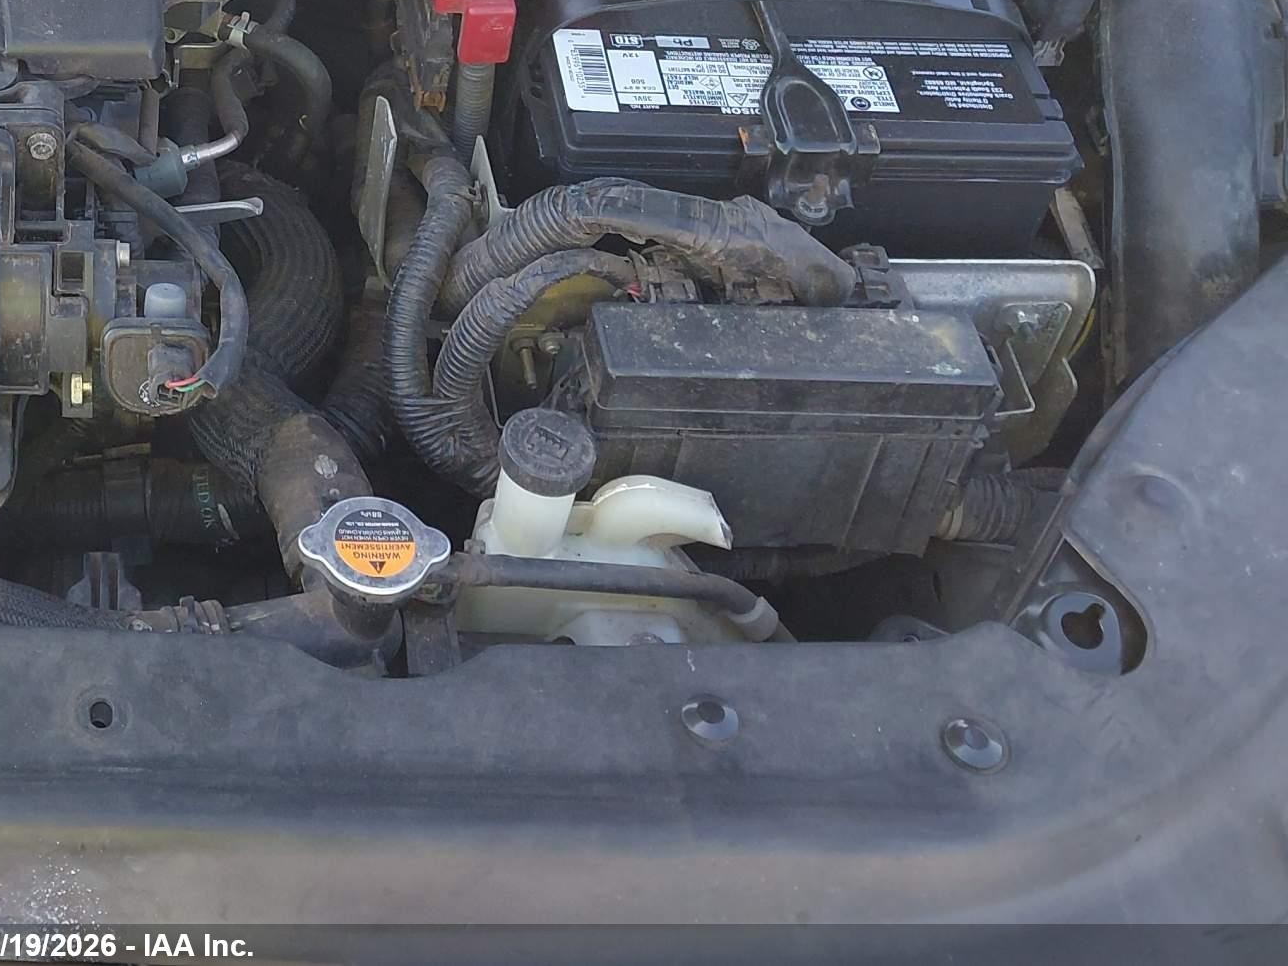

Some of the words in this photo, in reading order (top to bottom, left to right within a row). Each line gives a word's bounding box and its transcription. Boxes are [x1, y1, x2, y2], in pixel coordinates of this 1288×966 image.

[614, 35, 639, 45] STD
[673, 38, 694, 47] Pb
[341, 543, 411, 551] AVERTISSEMENT
[352, 551, 401, 560] WARNING
